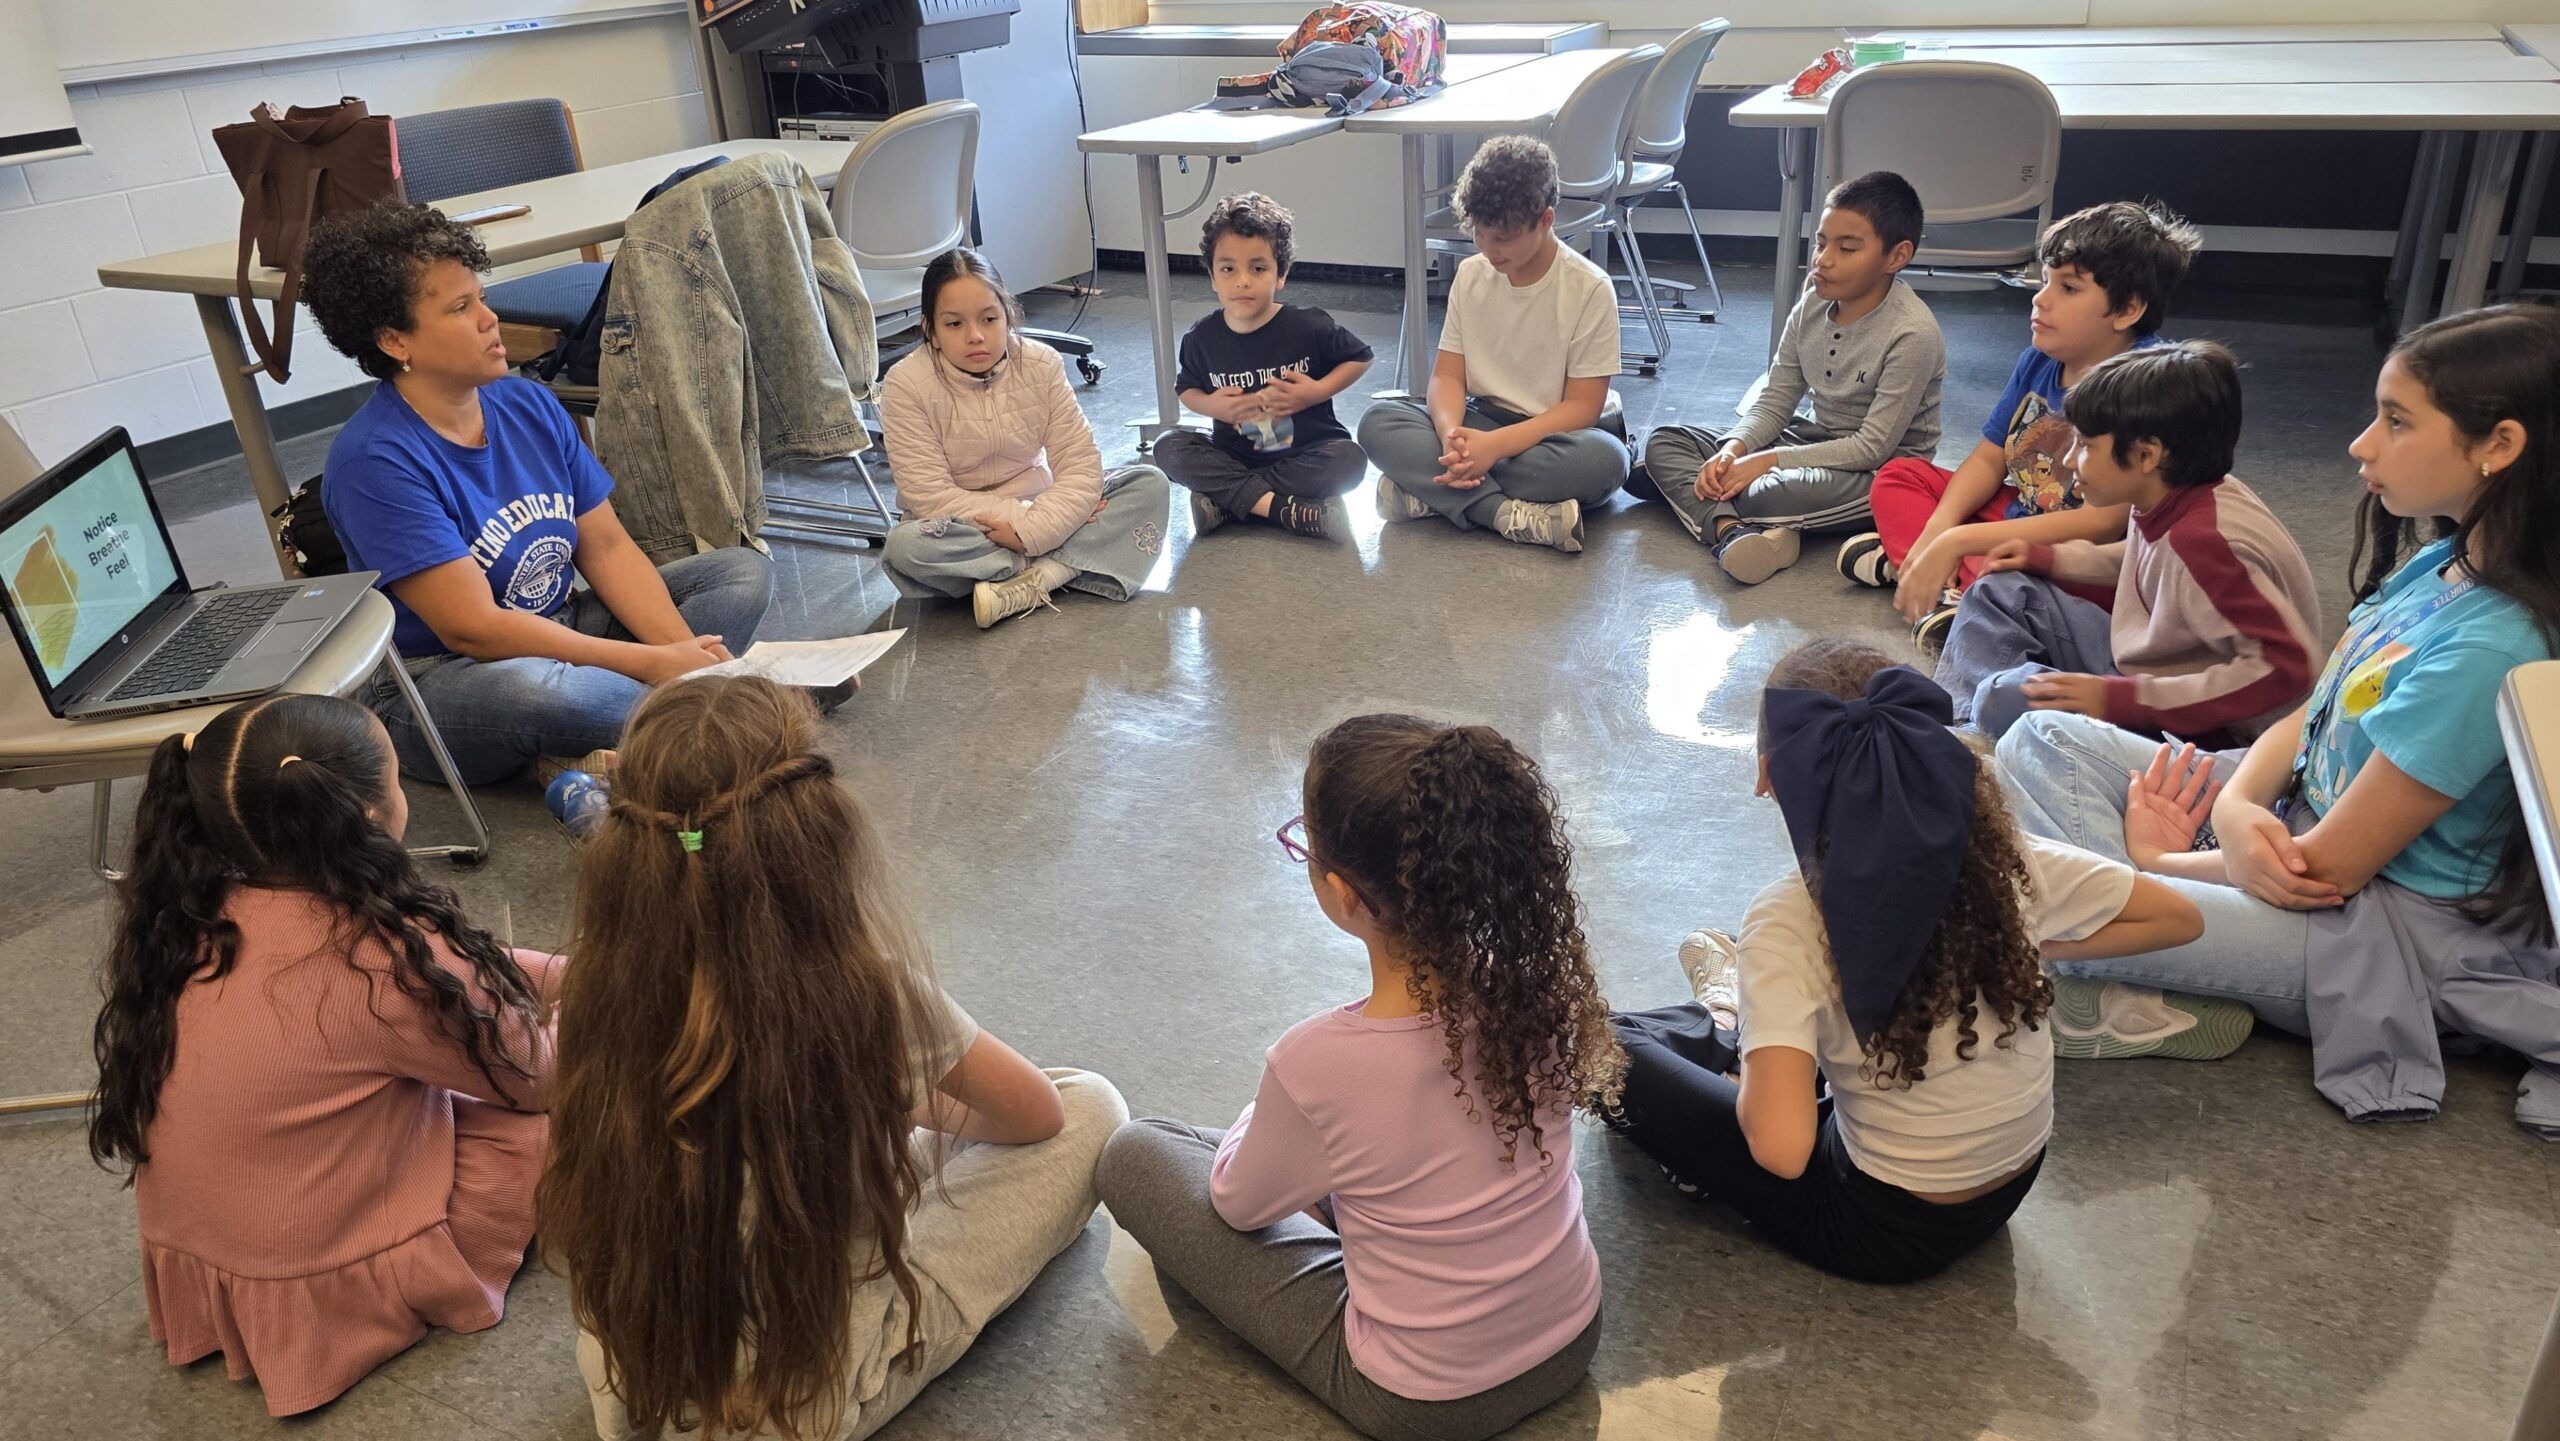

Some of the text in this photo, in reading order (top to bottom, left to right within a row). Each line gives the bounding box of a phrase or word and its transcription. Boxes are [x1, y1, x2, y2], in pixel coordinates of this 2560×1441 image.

[1229, 371, 1254, 388] FEED
[83, 512, 118, 543] Notice
[469, 518, 512, 569] TINO
[497, 492, 576, 533] EDUCAT
[106, 552, 130, 580] Feel
[531, 543, 554, 561] STATE
[2432, 577, 2475, 610] QUIRTLE
